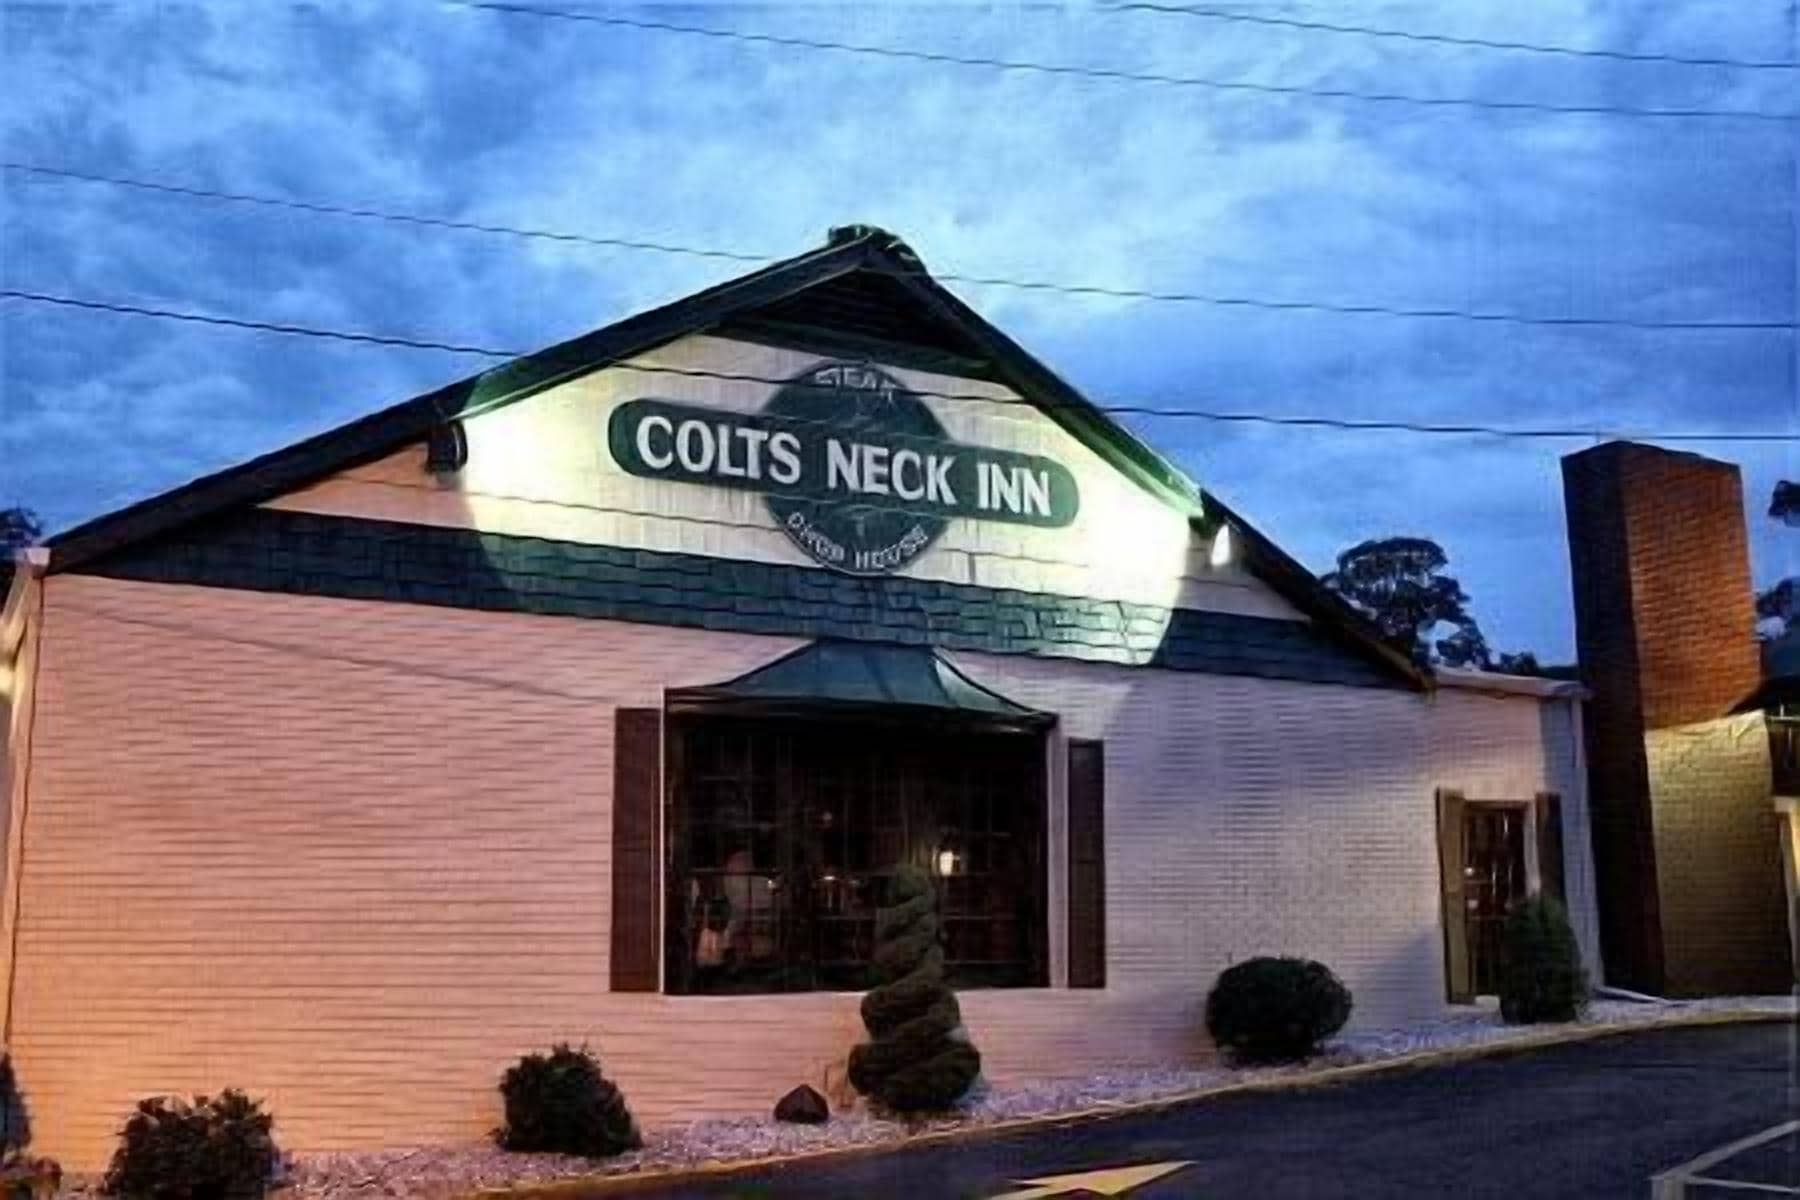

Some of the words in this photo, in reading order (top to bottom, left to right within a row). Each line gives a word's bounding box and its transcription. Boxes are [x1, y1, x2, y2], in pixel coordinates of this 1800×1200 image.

[636, 416, 801, 484] COLTS
[827, 439, 957, 505] NECK
[976, 462, 1052, 517] INN
